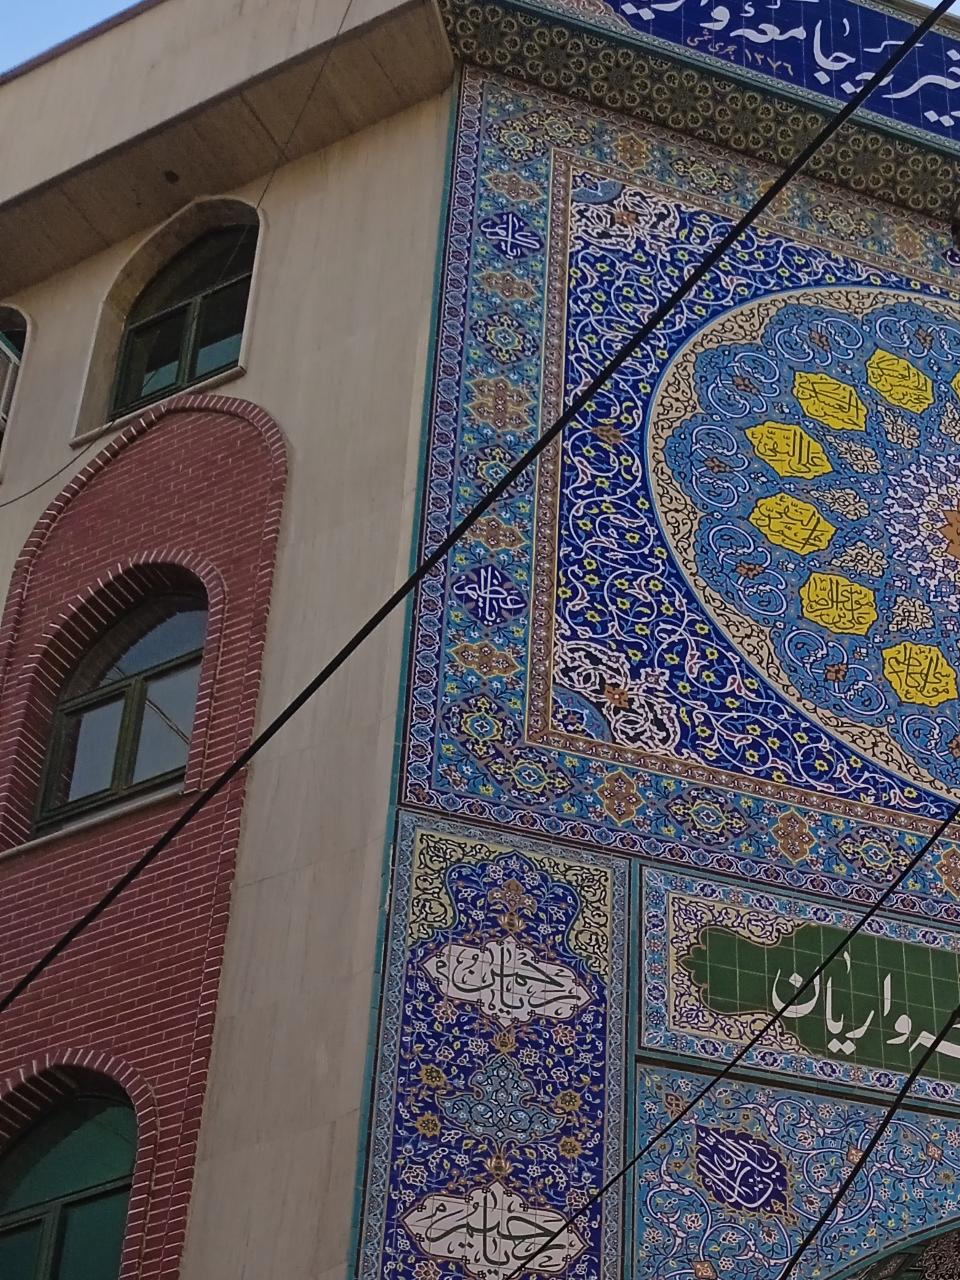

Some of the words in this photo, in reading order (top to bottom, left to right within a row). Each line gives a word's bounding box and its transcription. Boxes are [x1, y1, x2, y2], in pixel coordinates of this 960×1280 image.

[451, 948, 581, 1011] رحمن
[771, 950, 913, 1056] واریان
[425, 1205, 567, 1263] رحیم
